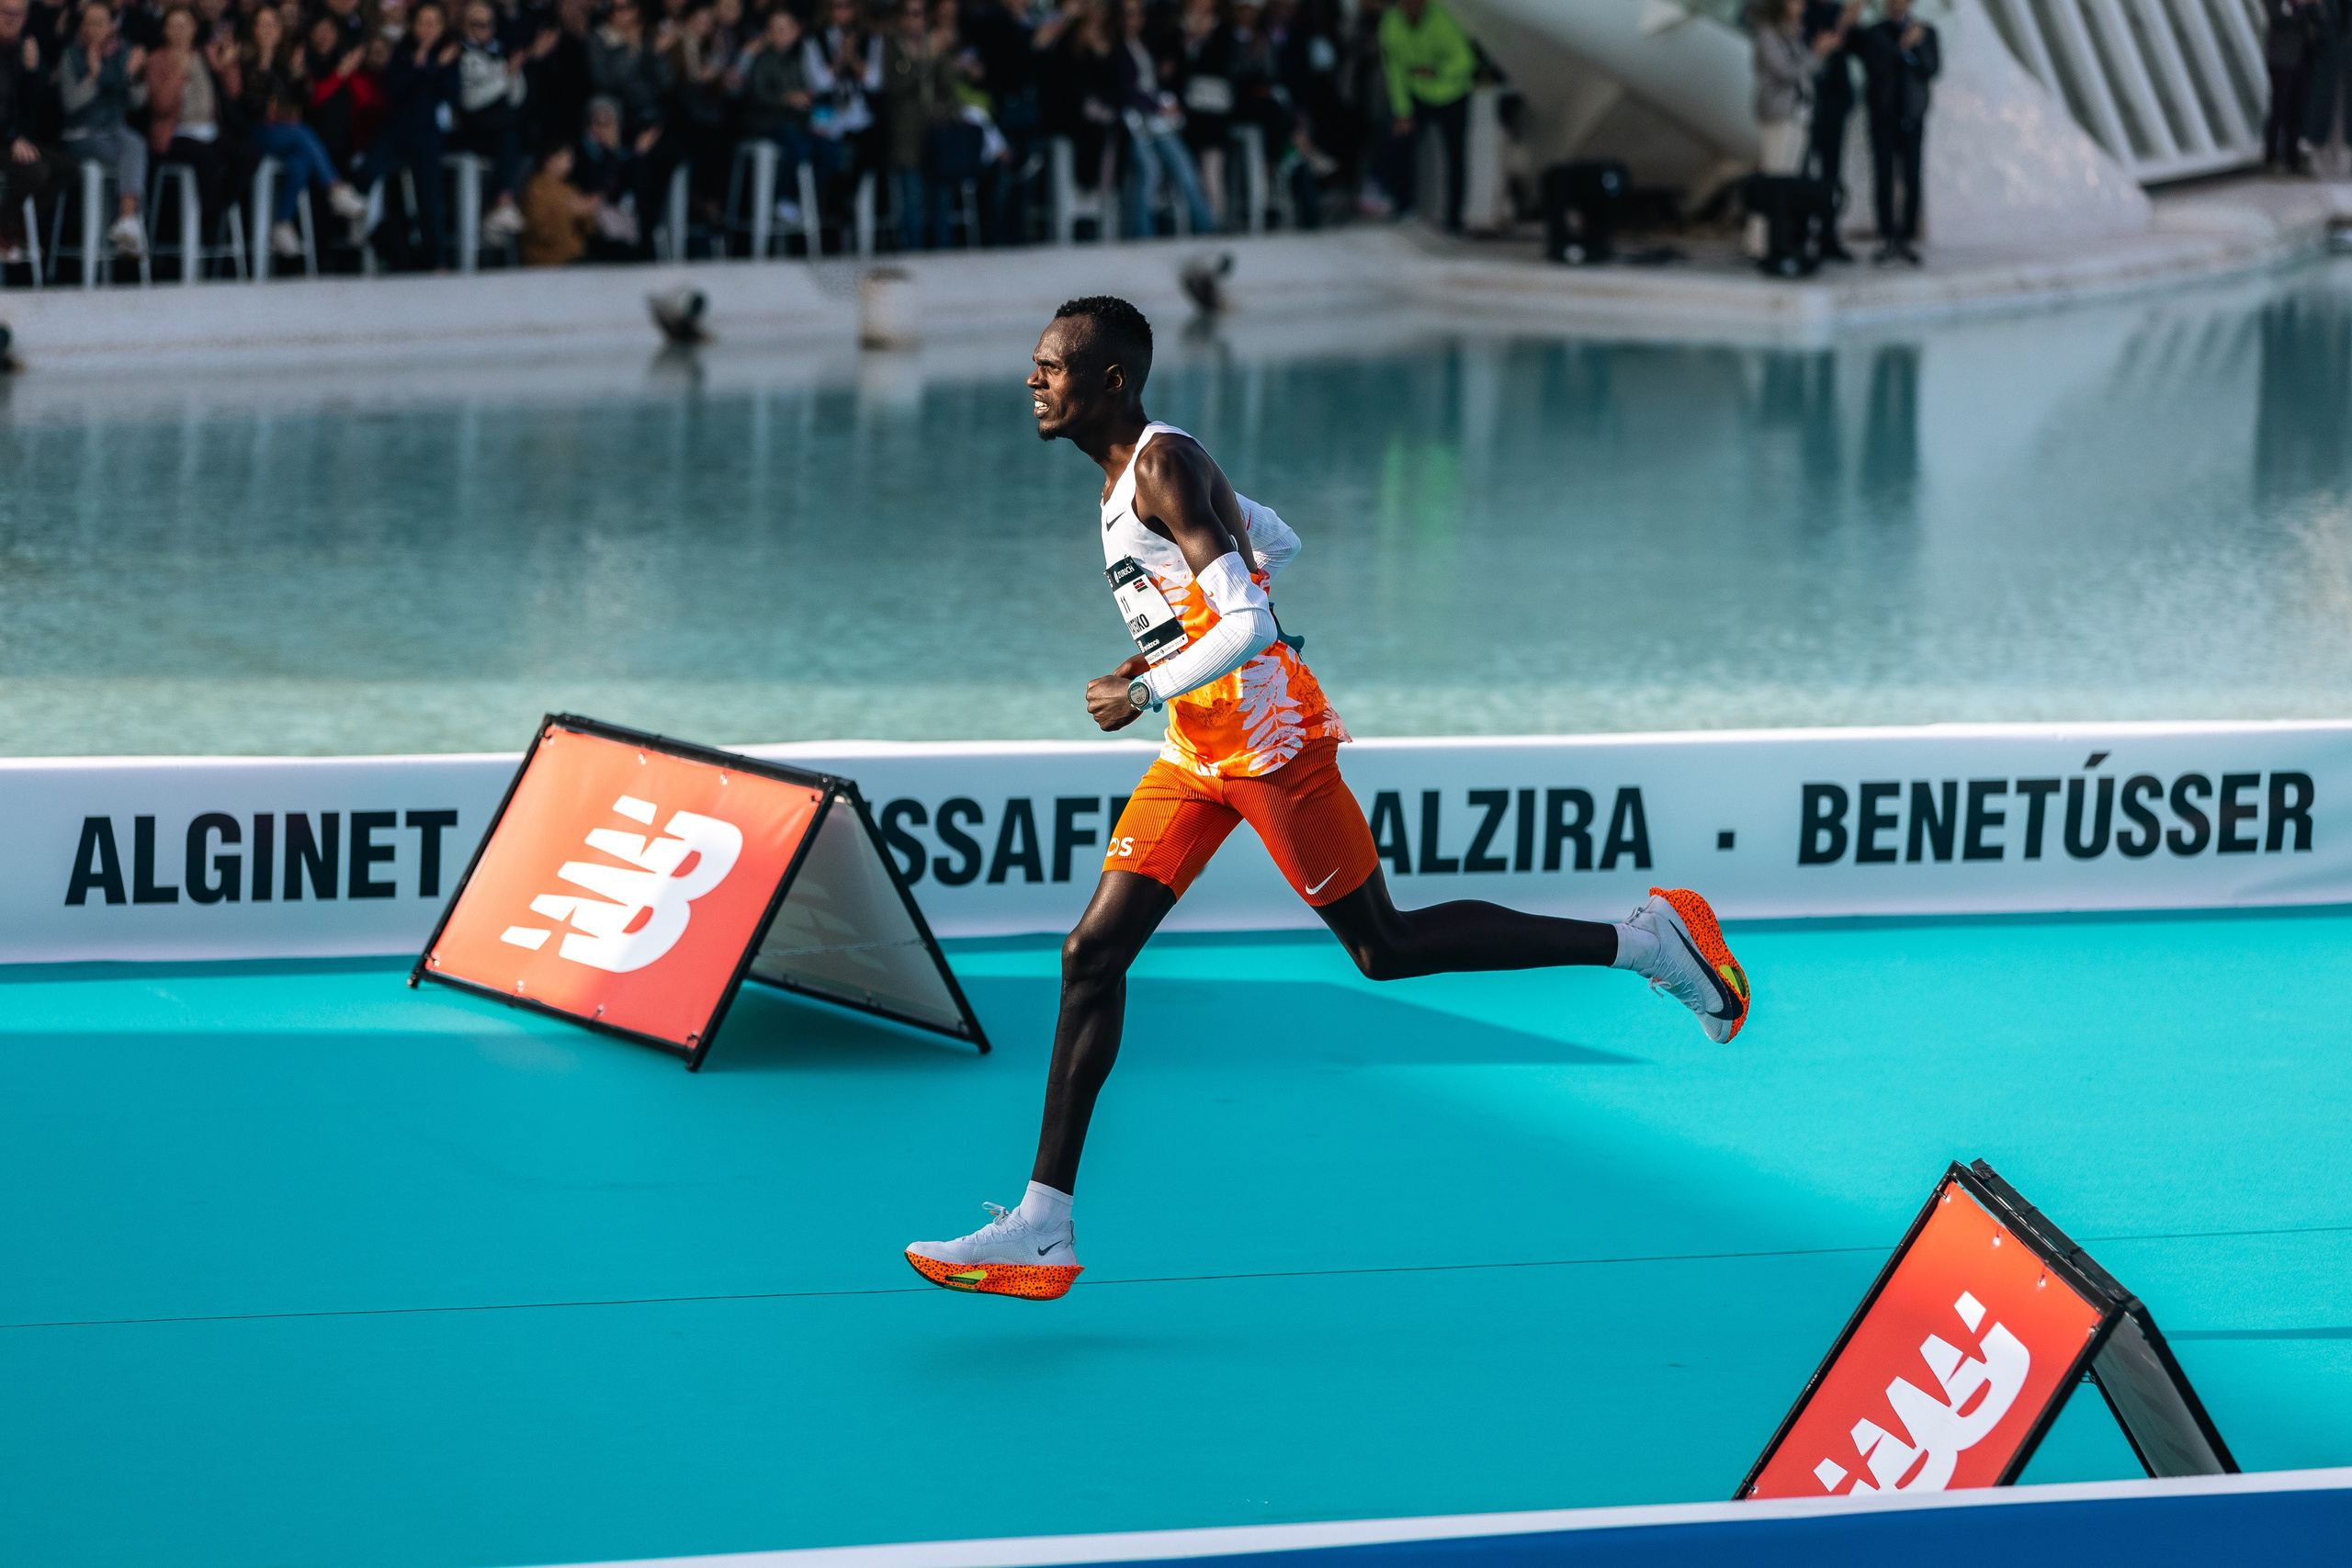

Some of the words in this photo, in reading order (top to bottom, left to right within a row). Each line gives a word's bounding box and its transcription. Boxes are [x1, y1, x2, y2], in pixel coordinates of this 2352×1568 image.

[1116, 564, 1136, 581] ZURICH
[1120, 594, 1131, 614] 11
[64, 810, 458, 907] ALGINET
[865, 795, 1130, 888] SSAF
[1370, 787, 1654, 875] ALZIRA
[1797, 751, 2316, 866] BENETÚSSER
